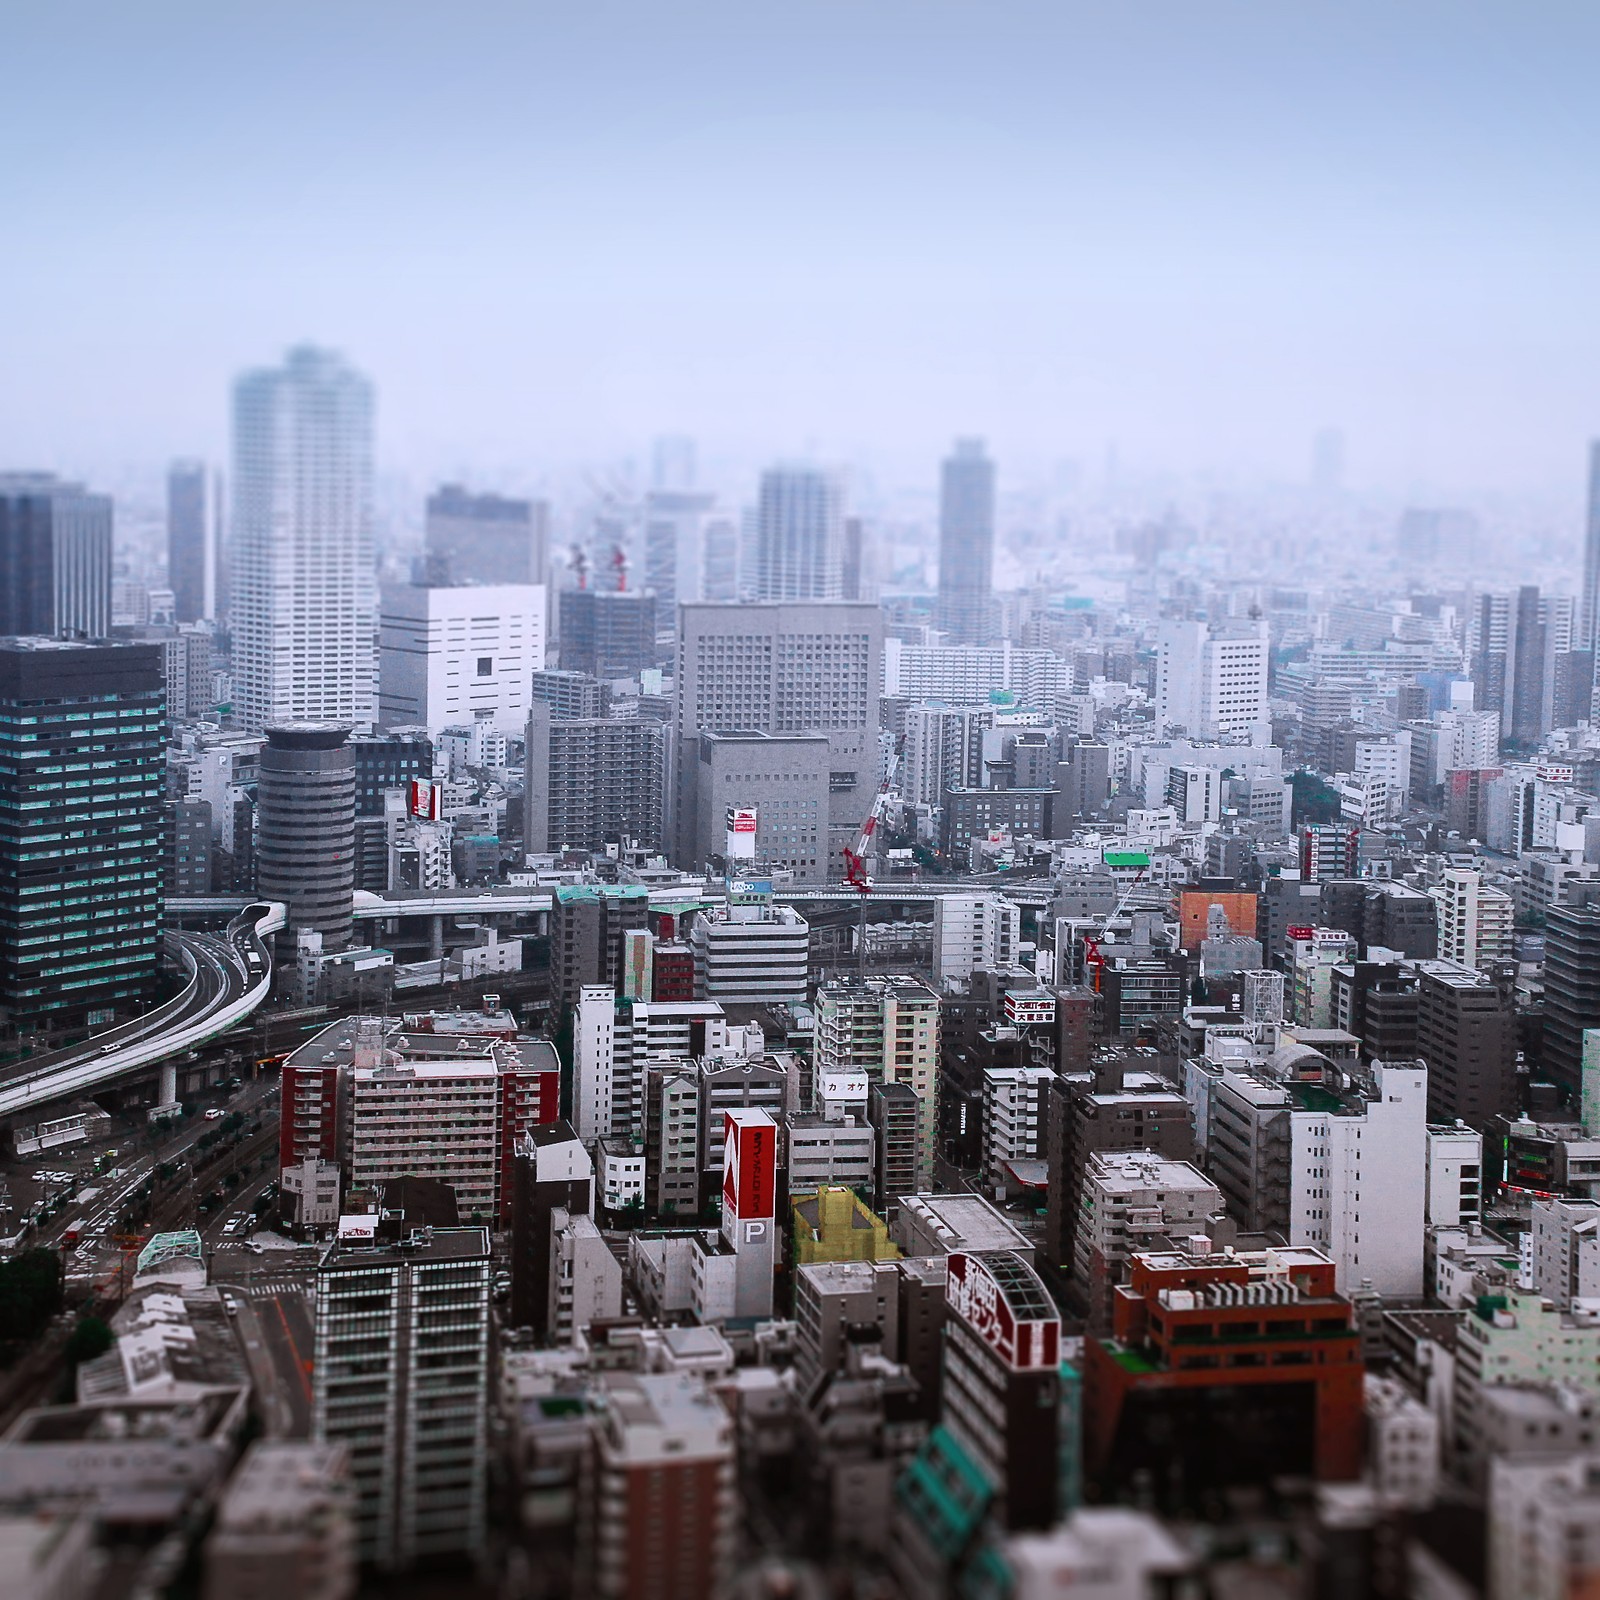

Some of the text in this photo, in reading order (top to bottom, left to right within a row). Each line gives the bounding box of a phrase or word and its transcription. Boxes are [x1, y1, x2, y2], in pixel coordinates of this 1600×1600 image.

[745, 1222, 766, 1243] P
[948, 1270, 1014, 1355] 研修センター
